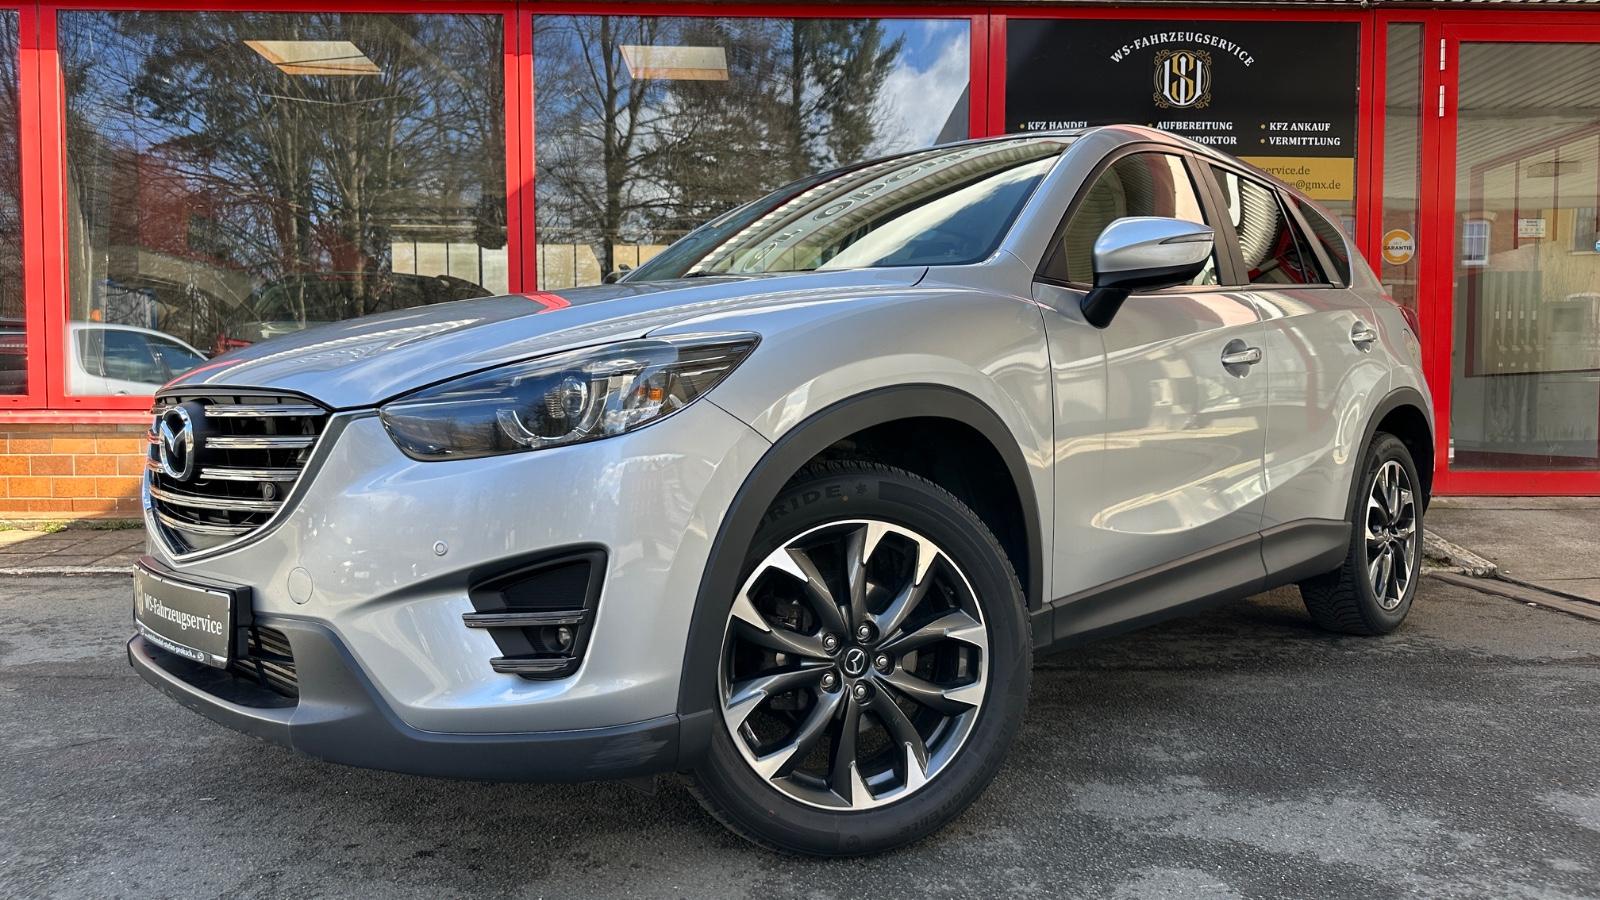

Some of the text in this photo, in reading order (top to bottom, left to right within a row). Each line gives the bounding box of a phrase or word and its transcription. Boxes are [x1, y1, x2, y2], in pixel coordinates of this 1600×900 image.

[1110, 31, 1254, 67] WS-FAHRZEUGSERVICE
[1027, 121, 1046, 130] KFZ
[1156, 121, 1233, 130] AUFBEREITUNG
[1269, 122, 1331, 131] KFZ ANKAUF
[1269, 136, 1341, 146] VERMITTLUNG
[1287, 180, 1341, 191] @gmx.de
[765, 485, 842, 524] RIDE
[144, 592, 223, 636] WS-Fahrzeugservice
